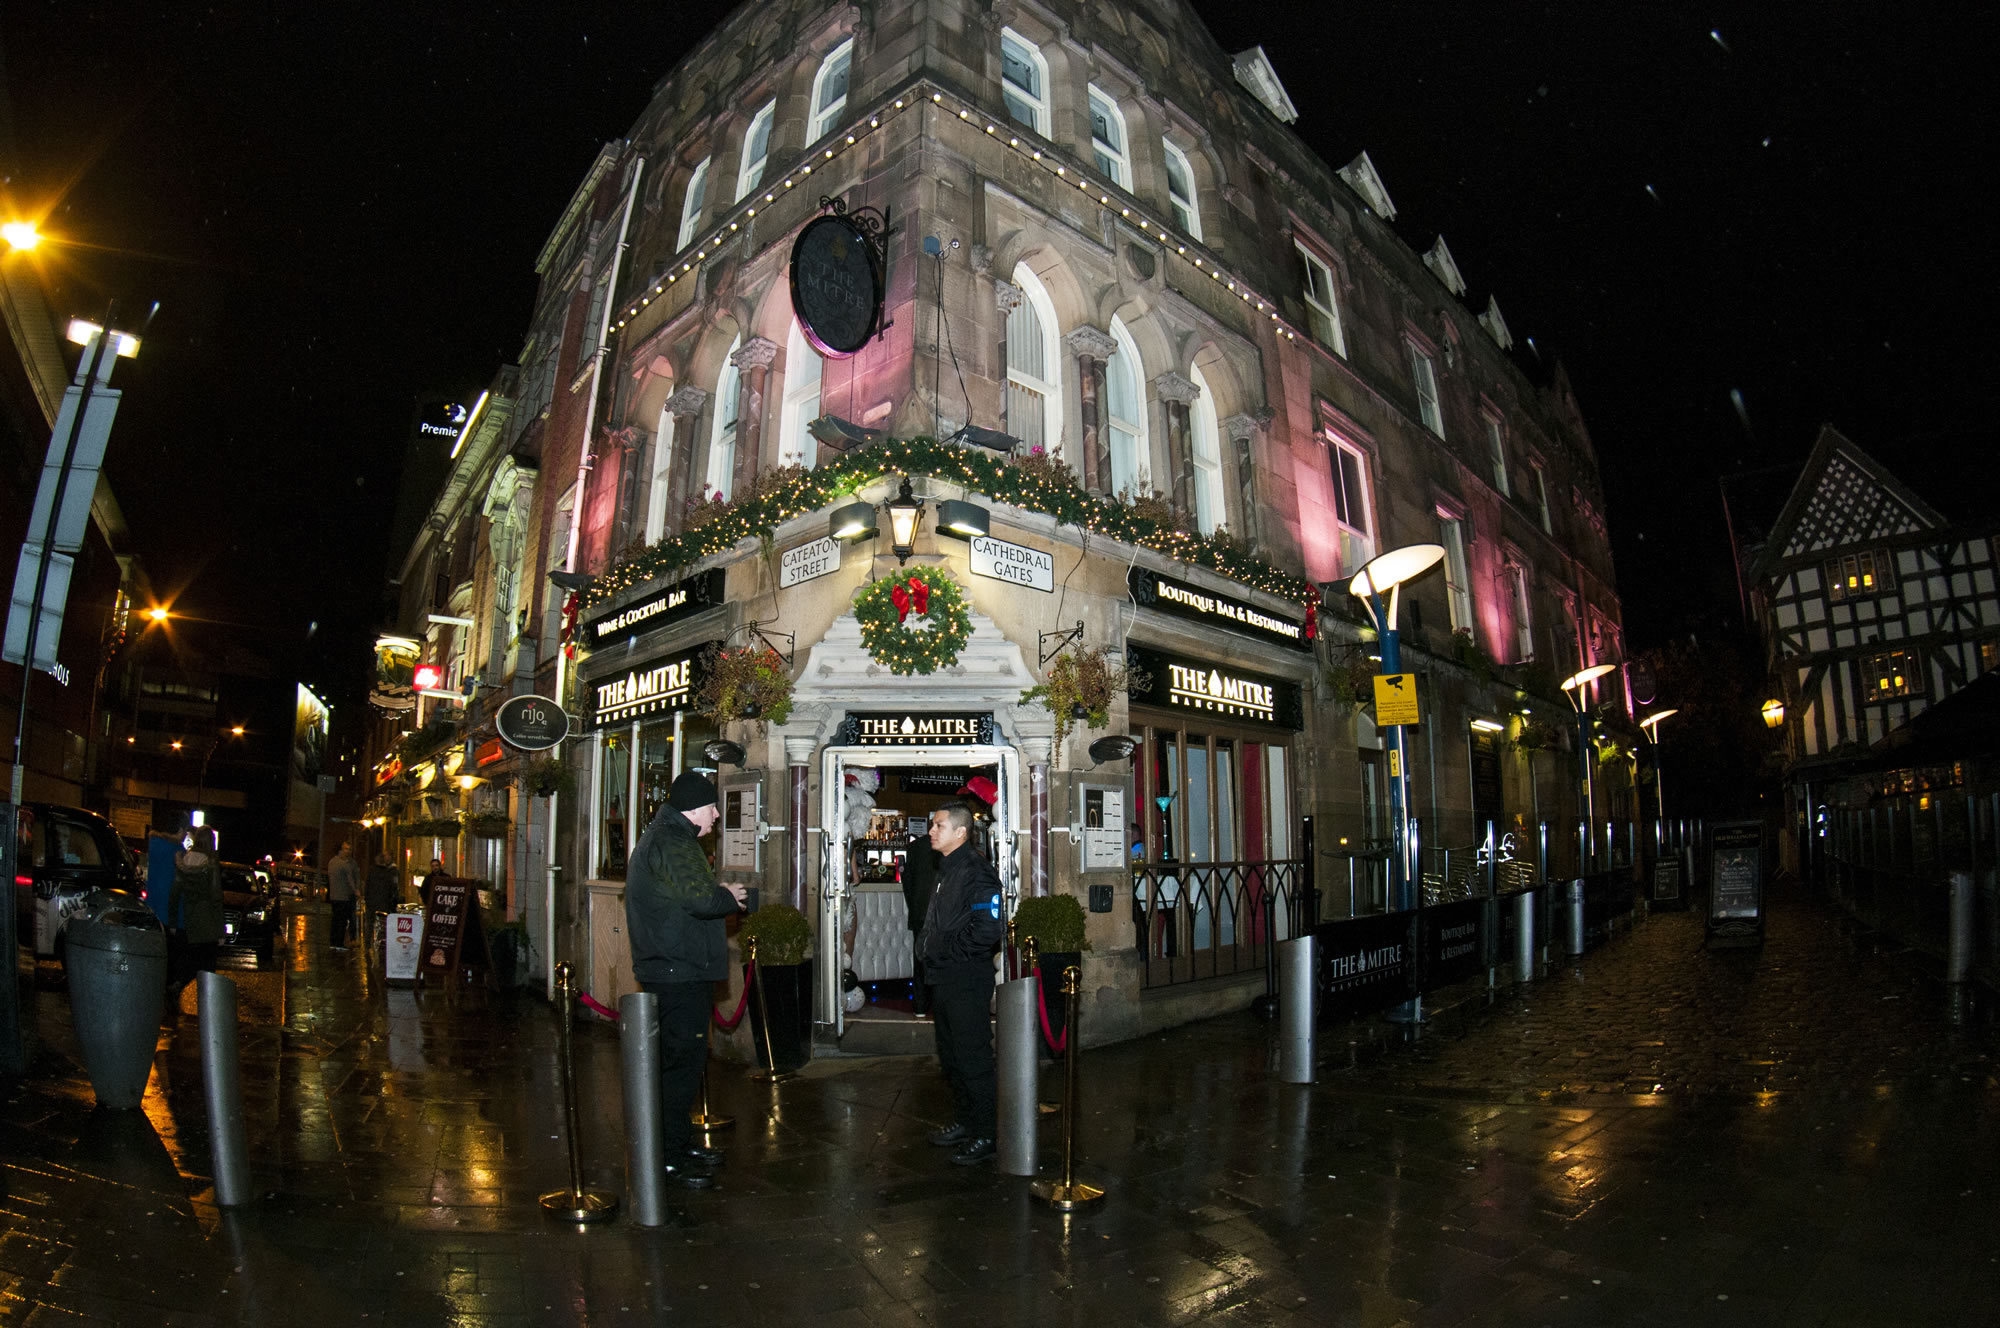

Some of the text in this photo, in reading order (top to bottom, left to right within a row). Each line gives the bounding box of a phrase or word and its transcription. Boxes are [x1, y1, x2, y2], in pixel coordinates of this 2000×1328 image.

[807, 272, 865, 312] MITRE
[421, 423, 458, 437] Premie
[973, 538, 1050, 571] CATHEDRAL
[790, 557, 829, 582] STREET
[994, 561, 1033, 583] GATES
[597, 590, 687, 637] WINE & COCKTAIL BAR
[1158, 581, 1300, 639] BOUTIQUE BAR & RESTAURANT
[598, 659, 690, 708] THE MITRE
[1168, 664, 1274, 707] THE MITRE
[596, 694, 688, 724] MANCHESTER
[1170, 694, 1274, 720] MANCHESTER
[860, 719, 978, 734] THE MITRE
[437, 894, 458, 906] CAKE
[398, 920, 412, 932] illy
[432, 914, 458, 925] COFFEE
[1331, 944, 1402, 978] THE MITRE
[1331, 967, 1401, 992] MANCHESTER
